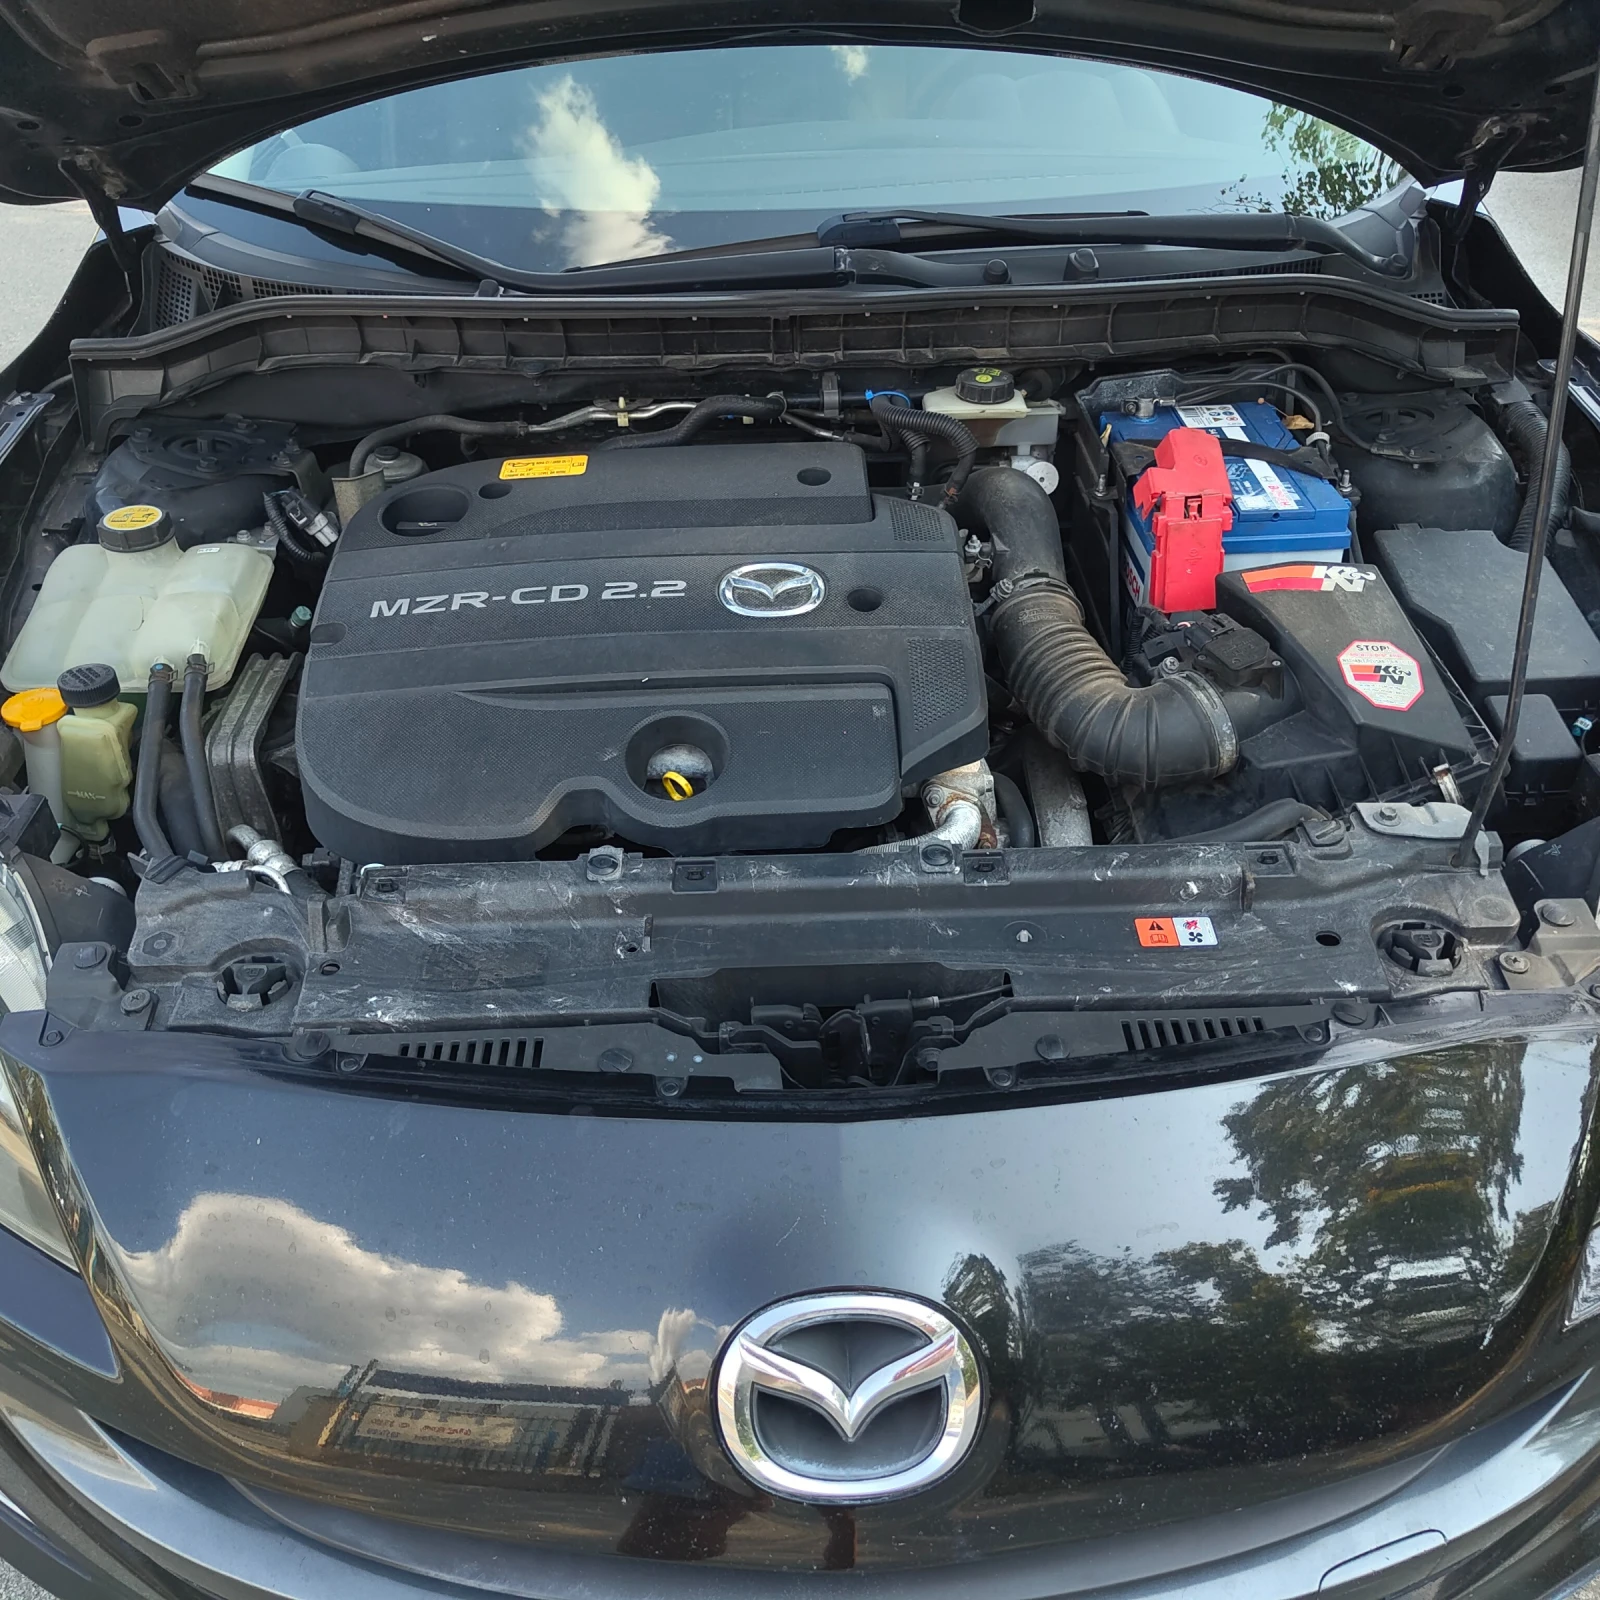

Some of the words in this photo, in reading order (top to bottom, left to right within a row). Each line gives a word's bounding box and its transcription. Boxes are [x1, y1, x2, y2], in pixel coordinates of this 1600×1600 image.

[1312, 565, 1377, 593] K&N
[369, 584, 589, 618] MZR-CD
[601, 580, 687, 600] 2.2
[1373, 665, 1412, 685] K&N
